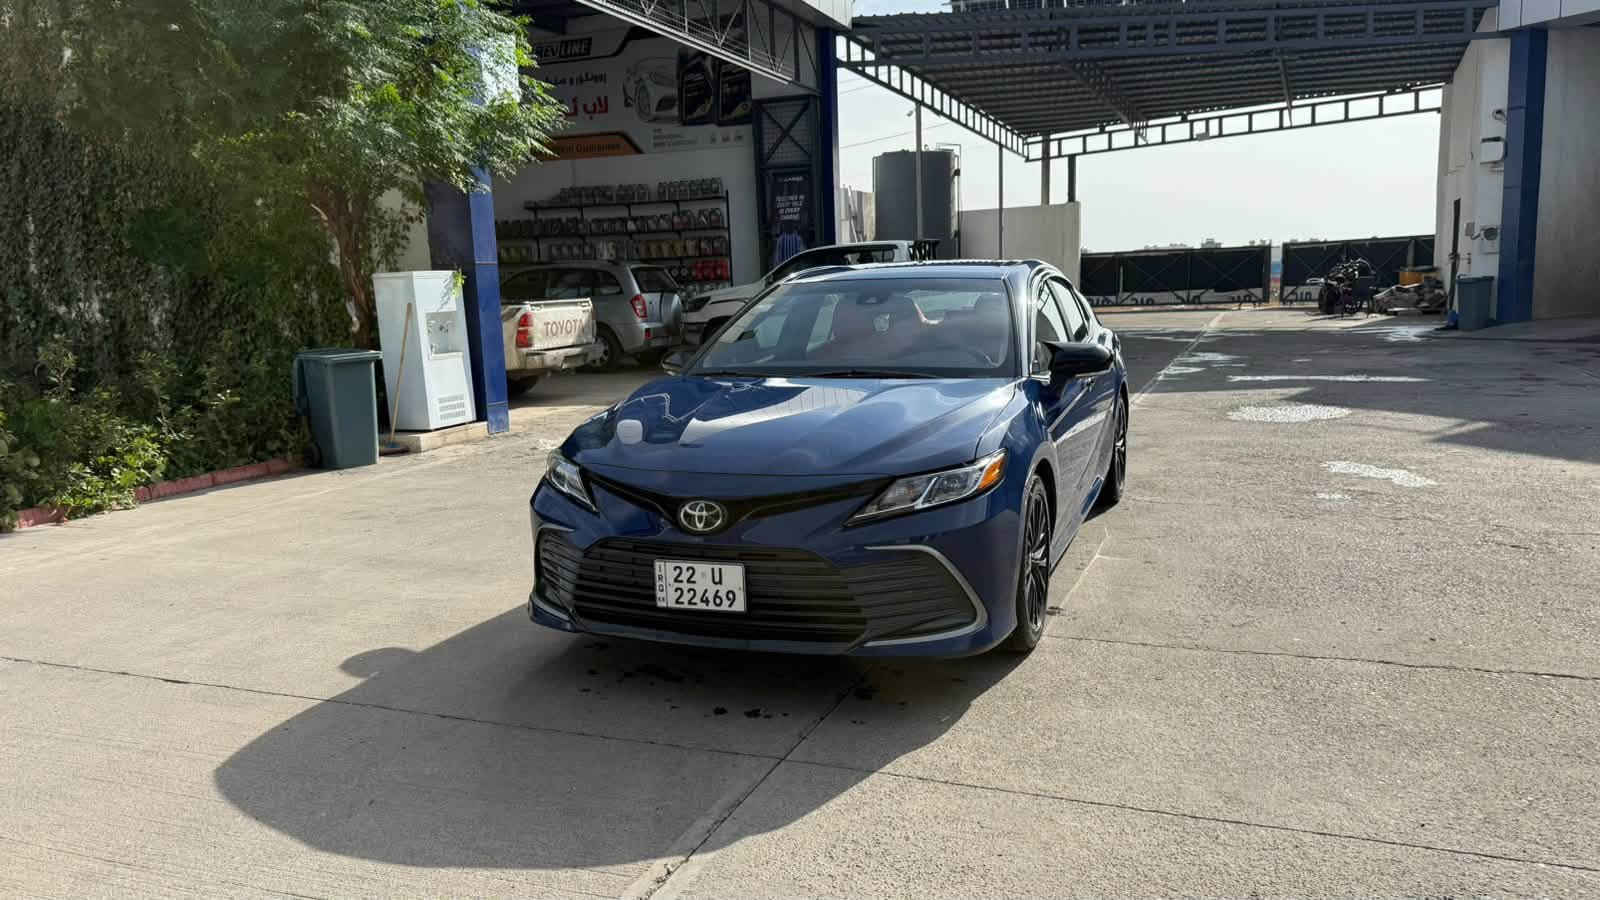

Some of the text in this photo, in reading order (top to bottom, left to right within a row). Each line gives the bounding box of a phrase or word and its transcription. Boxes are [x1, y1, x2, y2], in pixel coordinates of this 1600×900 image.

[544, 319, 584, 336] TOYOTA
[673, 566, 722, 585] 22 U
[674, 587, 736, 608] 22469
